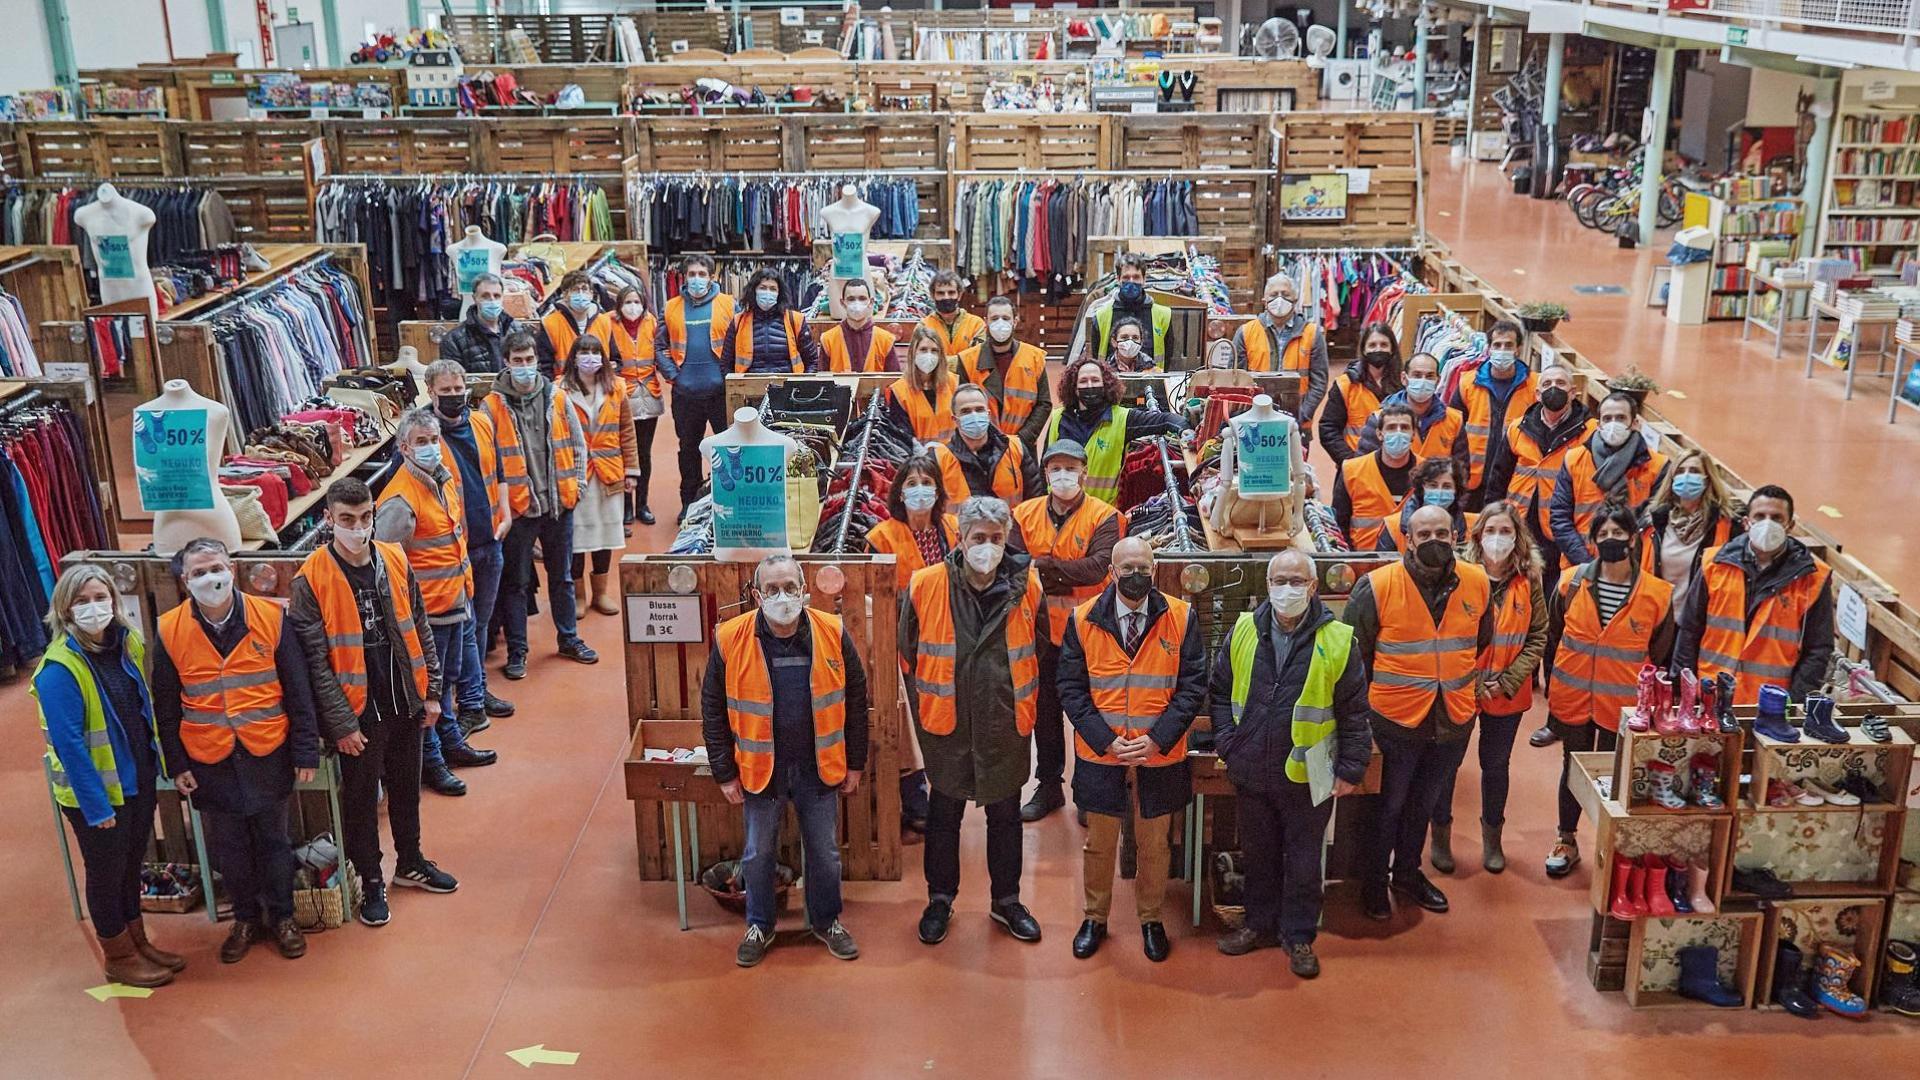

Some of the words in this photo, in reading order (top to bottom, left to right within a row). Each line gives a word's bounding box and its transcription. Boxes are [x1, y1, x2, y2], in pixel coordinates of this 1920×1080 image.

[167, 428, 205, 446] 50%
[1261, 434, 1288, 447] 50%
[744, 466, 783, 483] 50%
[649, 601, 677, 609] Blusas
[649, 613, 679, 621] Atorrak
[659, 625, 673, 635] 3€
